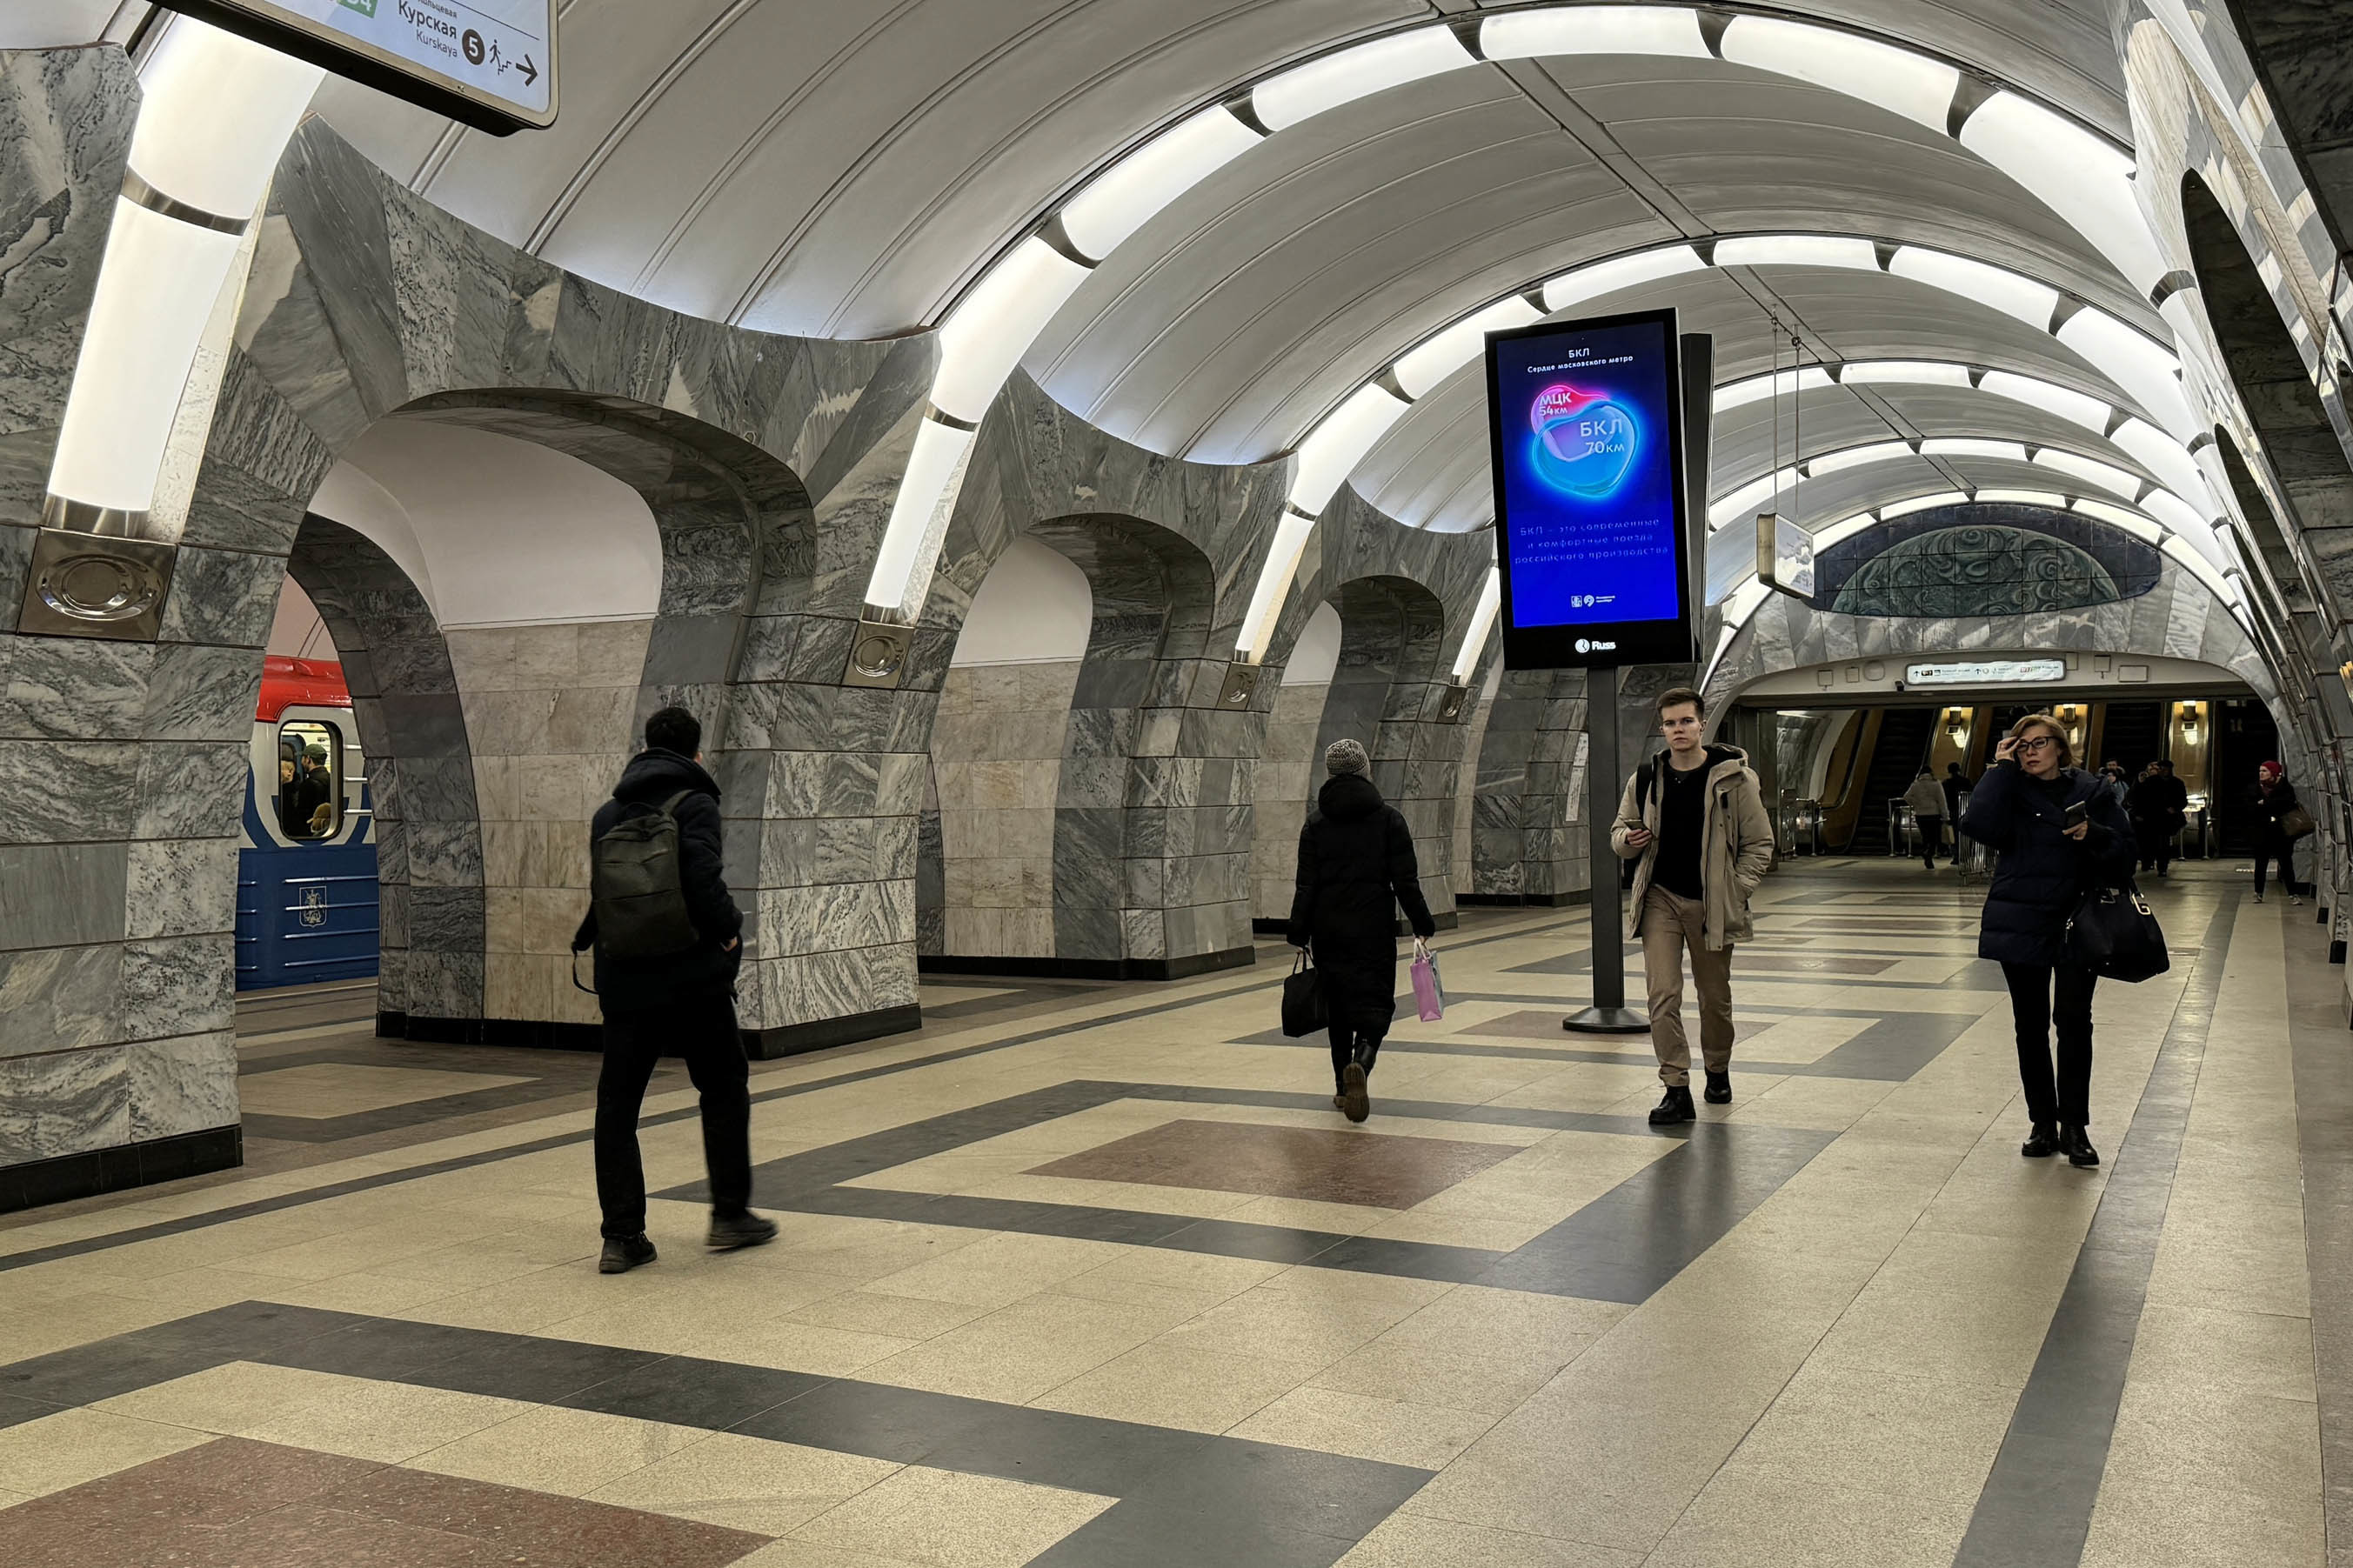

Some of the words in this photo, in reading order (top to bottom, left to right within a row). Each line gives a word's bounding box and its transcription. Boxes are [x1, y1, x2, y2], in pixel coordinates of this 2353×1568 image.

[418, 0, 458, 18] ольцевая
[398, 0, 458, 39] Курская
[416, 30, 458, 57] Kurskaya
[468, 37, 478, 57] 5
[1568, 348, 1590, 358] БКЛ
[1527, 364, 1555, 373] Сердце
[1557, 359, 1607, 370] московского
[1540, 392, 1572, 405] МЦК
[1580, 418, 1622, 437] БКЛ
[1520, 526, 1543, 537] БКЛ
[1591, 640, 1616, 651] Russ
